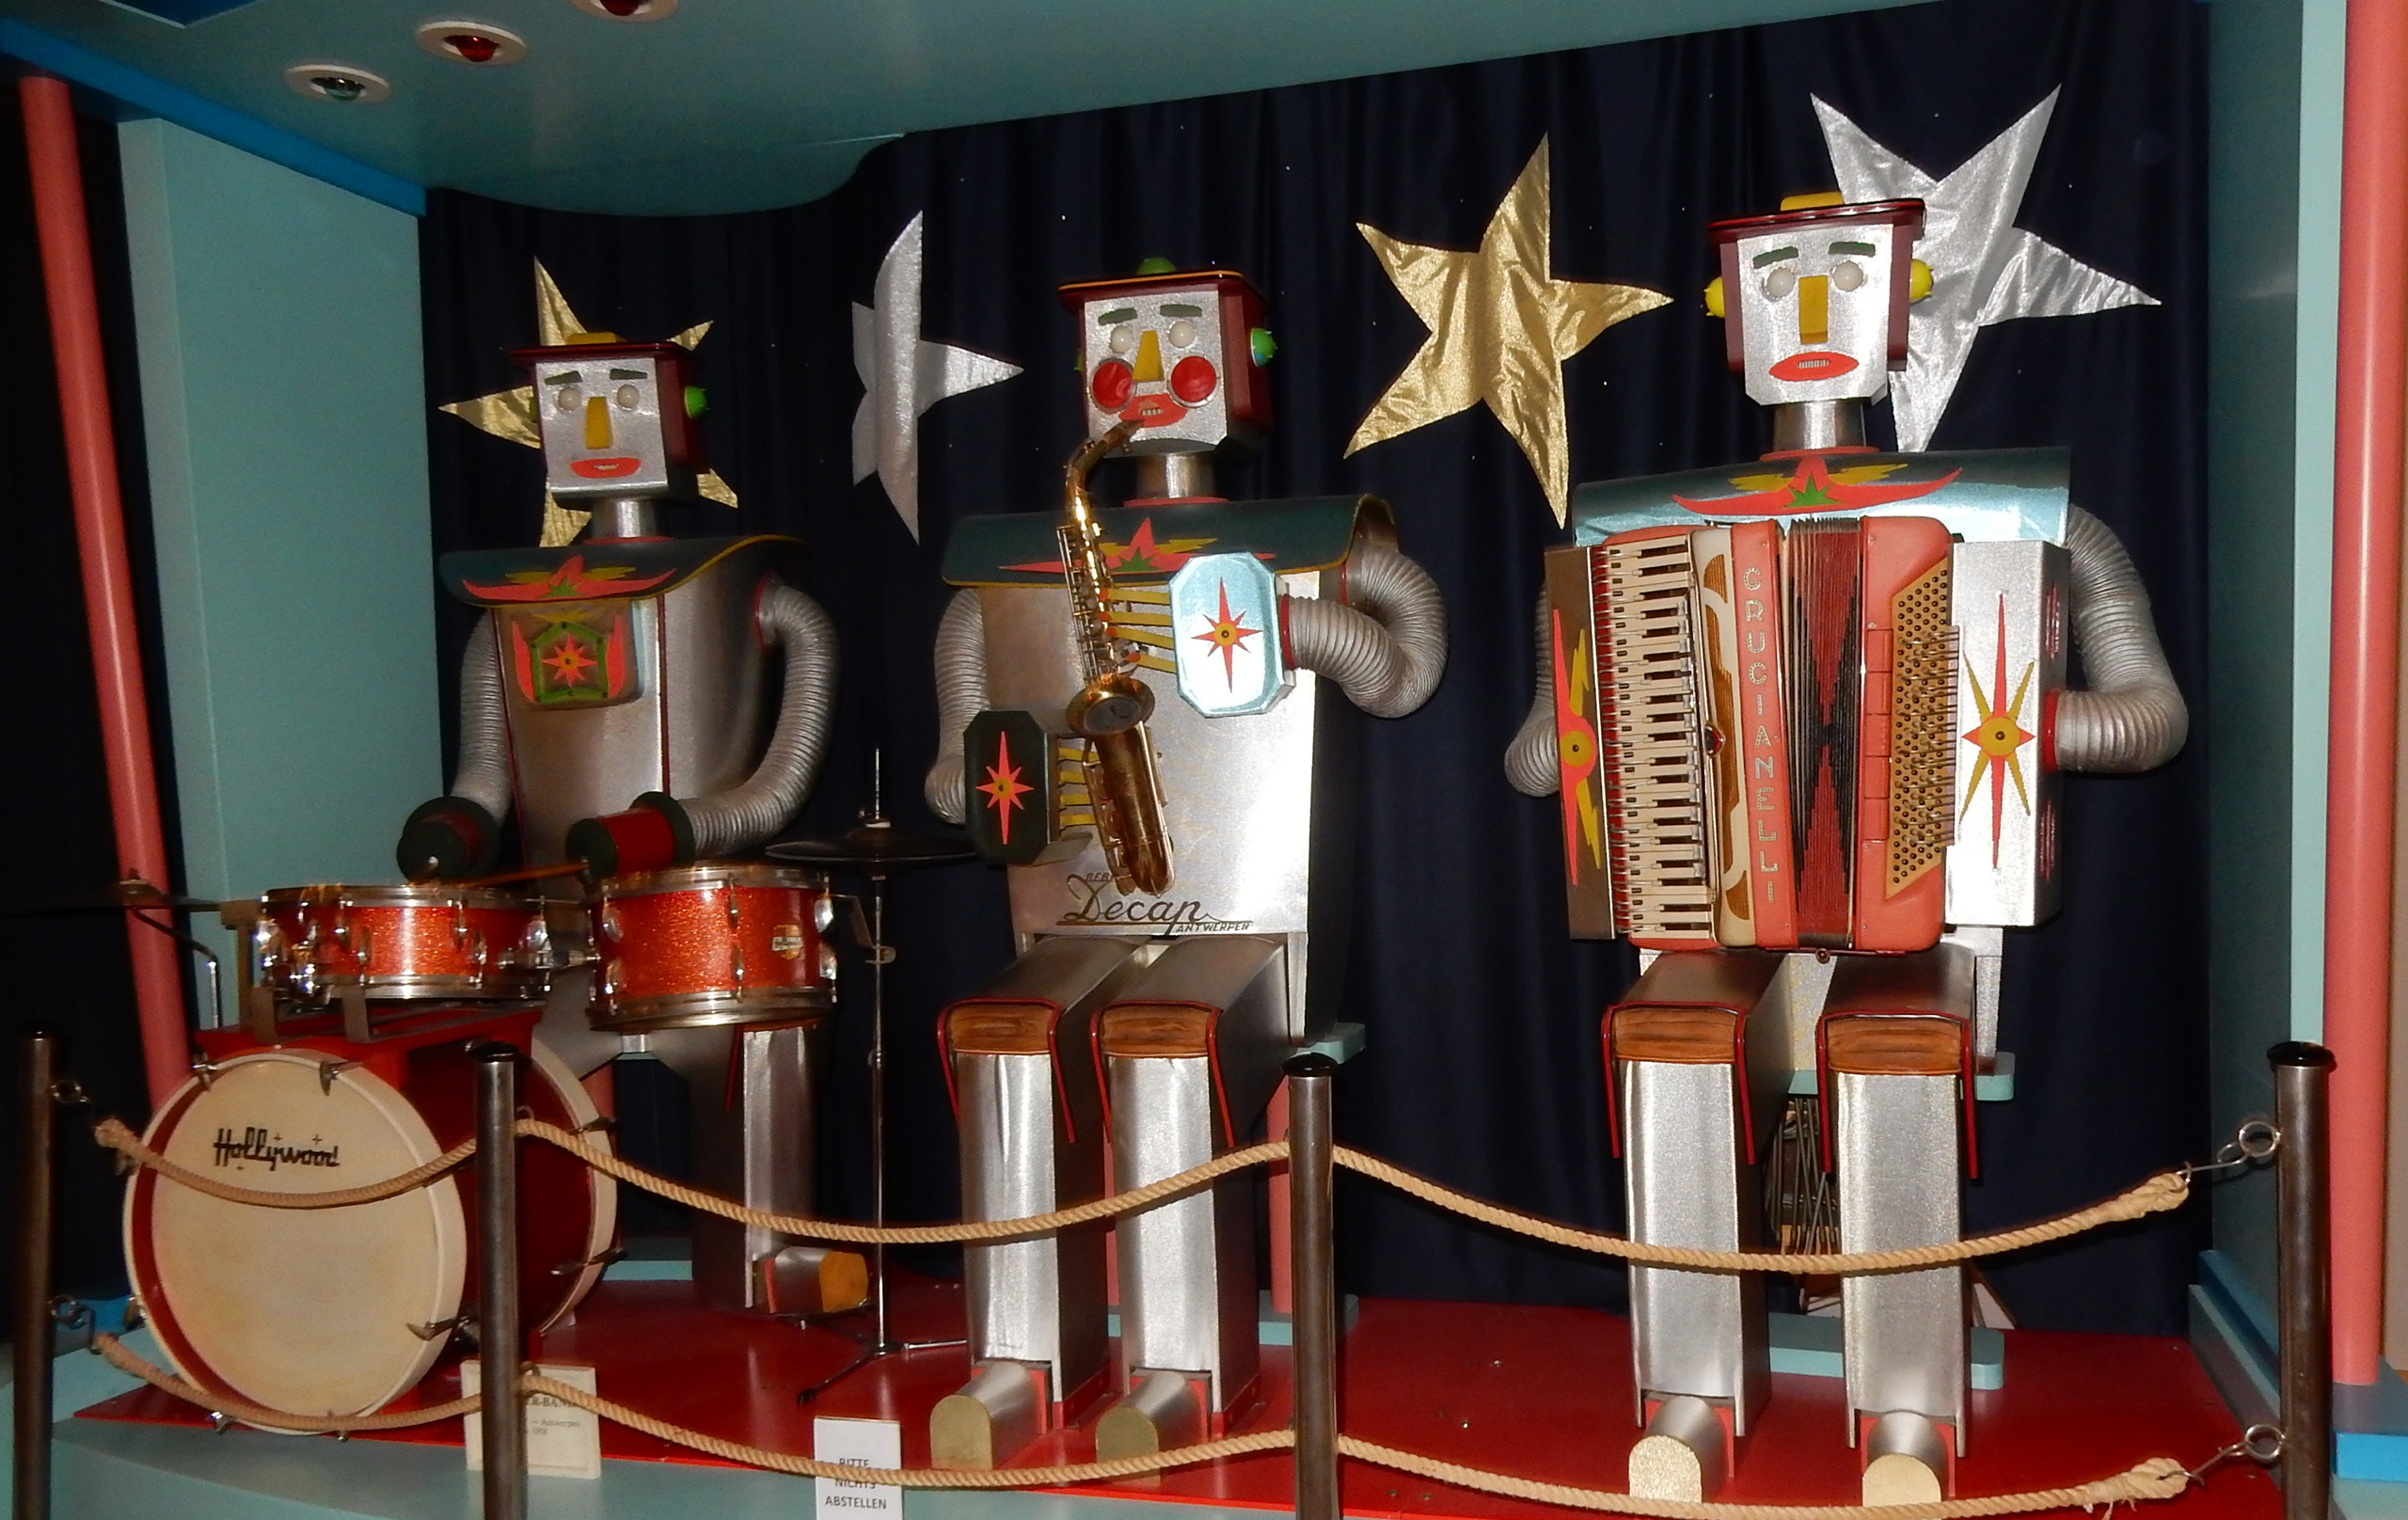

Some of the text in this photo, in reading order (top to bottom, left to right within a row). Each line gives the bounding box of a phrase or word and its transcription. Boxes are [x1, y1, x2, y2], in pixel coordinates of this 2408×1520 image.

[1743, 566, 1779, 903] CRUCIANELLI
[1176, 922, 1253, 933] ANTWERPEN
[214, 1127, 341, 1171] Hollywood
[825, 1496, 887, 1510] ABSTELLEN
